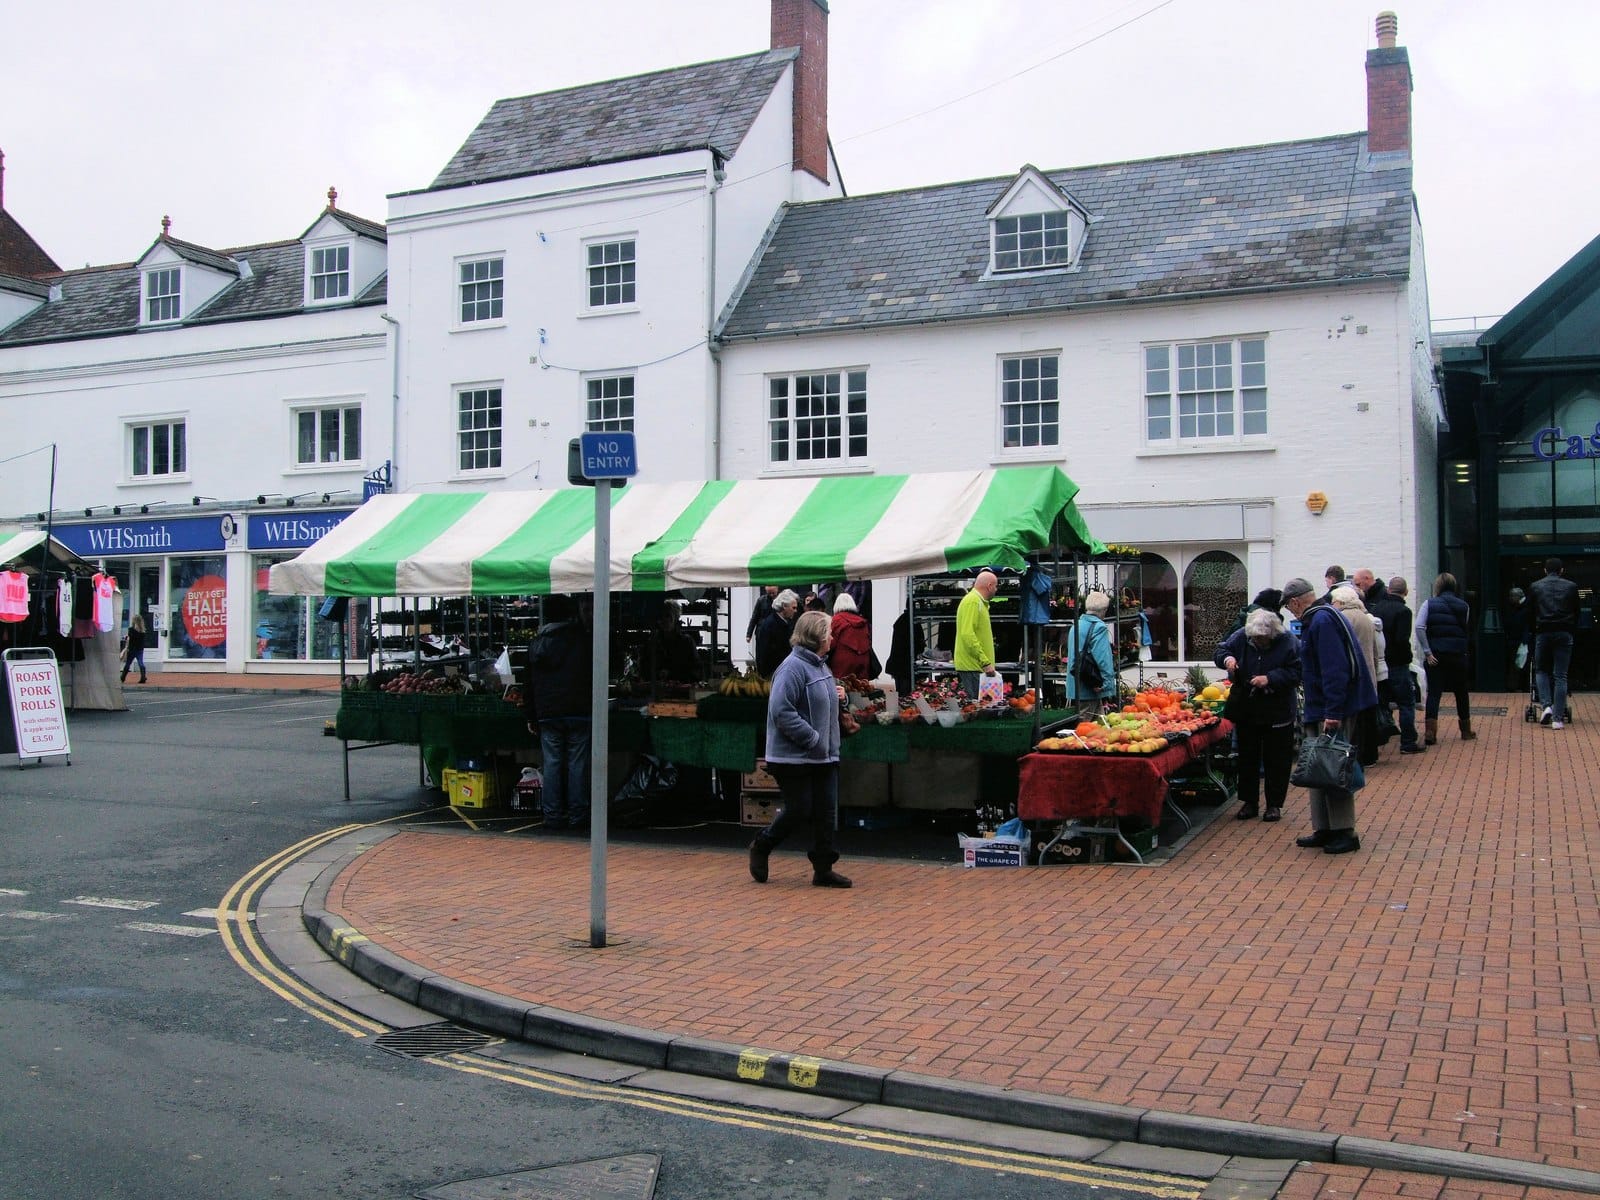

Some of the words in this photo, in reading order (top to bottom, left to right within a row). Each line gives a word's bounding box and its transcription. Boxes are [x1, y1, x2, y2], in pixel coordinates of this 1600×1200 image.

[598, 441, 619, 454] NO
[587, 455, 631, 469] ENTRY
[264, 519, 344, 541] WHSmi
[88, 526, 172, 550] WHSmith
[188, 591, 203, 600] BUY
[210, 589, 226, 599] GET
[192, 614, 227, 627] PRICE
[15, 671, 52, 683] ROAST
[20, 685, 52, 697] PORK
[21, 699, 56, 711] ROLLS
[23, 717, 36, 725] with
[32, 734, 54, 743] £3.50
